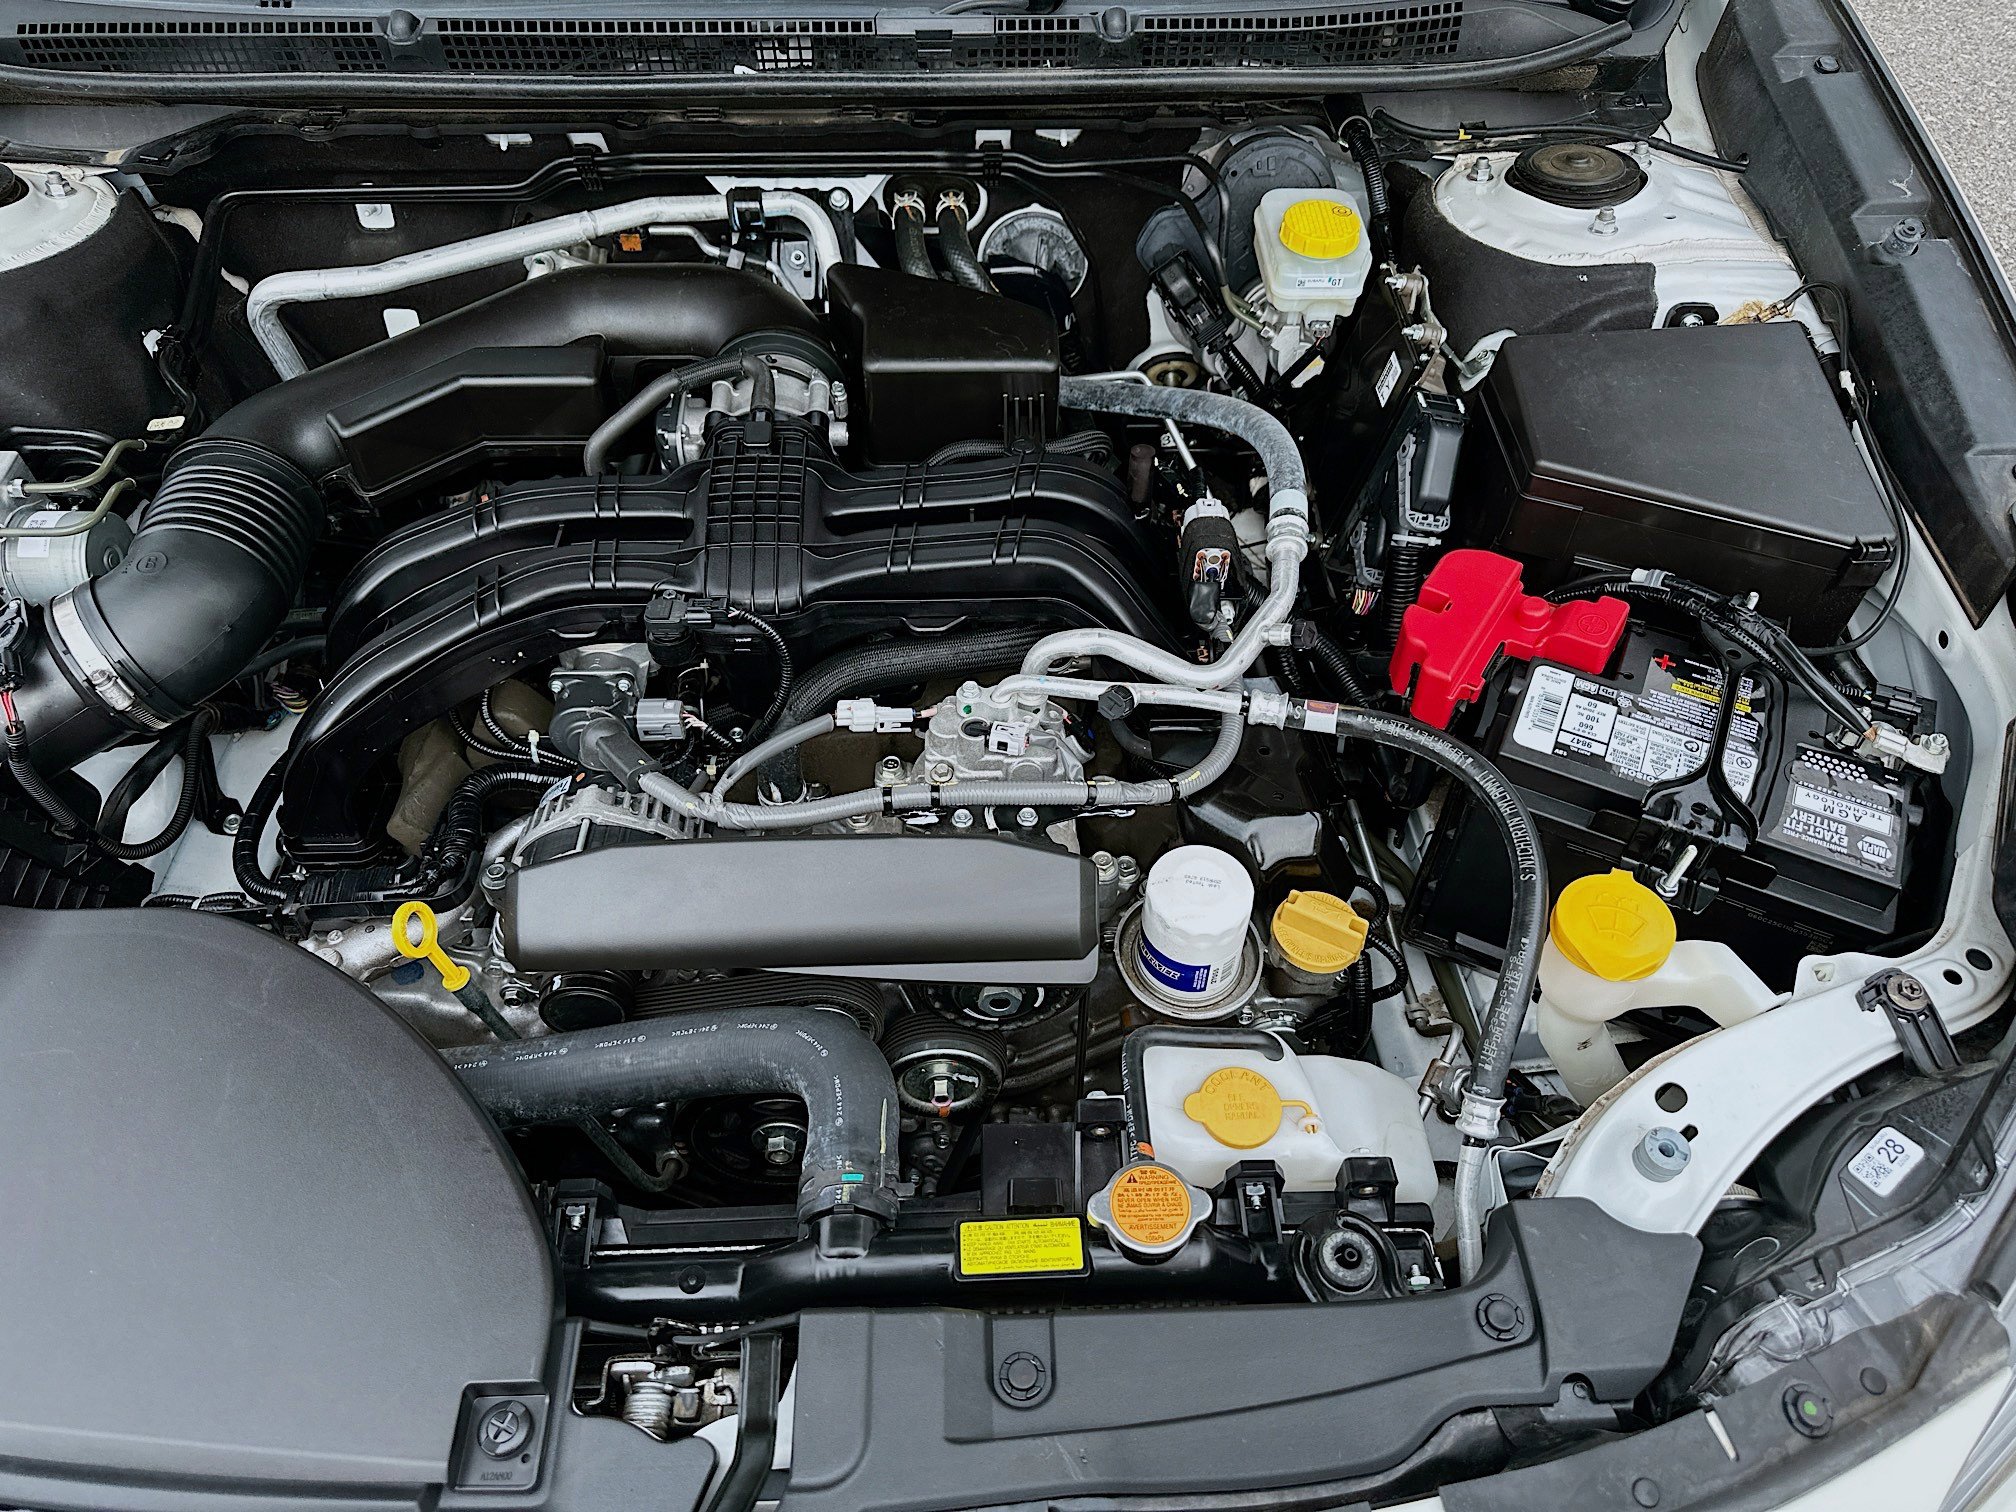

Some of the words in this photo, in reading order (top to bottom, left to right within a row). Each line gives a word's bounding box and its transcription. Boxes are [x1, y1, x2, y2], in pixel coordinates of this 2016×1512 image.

[1588, 701, 1598, 709] 60
[1579, 721, 1594, 731] 660
[1585, 714, 1600, 723] 100
[1570, 737, 1592, 749] 9847
[1805, 792, 1882, 821] TECHNOLOGY
[1823, 804, 1863, 822] AGM
[1790, 808, 1847, 835] BATTERY
[1783, 817, 1848, 847] EXACT-FIT
[1862, 841, 1887, 858] NAPA
[1478, 1038, 1491, 1068] 11HP
[1205, 1069, 1271, 1095] COOLANT
[1877, 1139, 1905, 1164] 28
[985, 1223, 1004, 1231] CAUTION
[1005, 1222, 1030, 1230] ATTENTION
